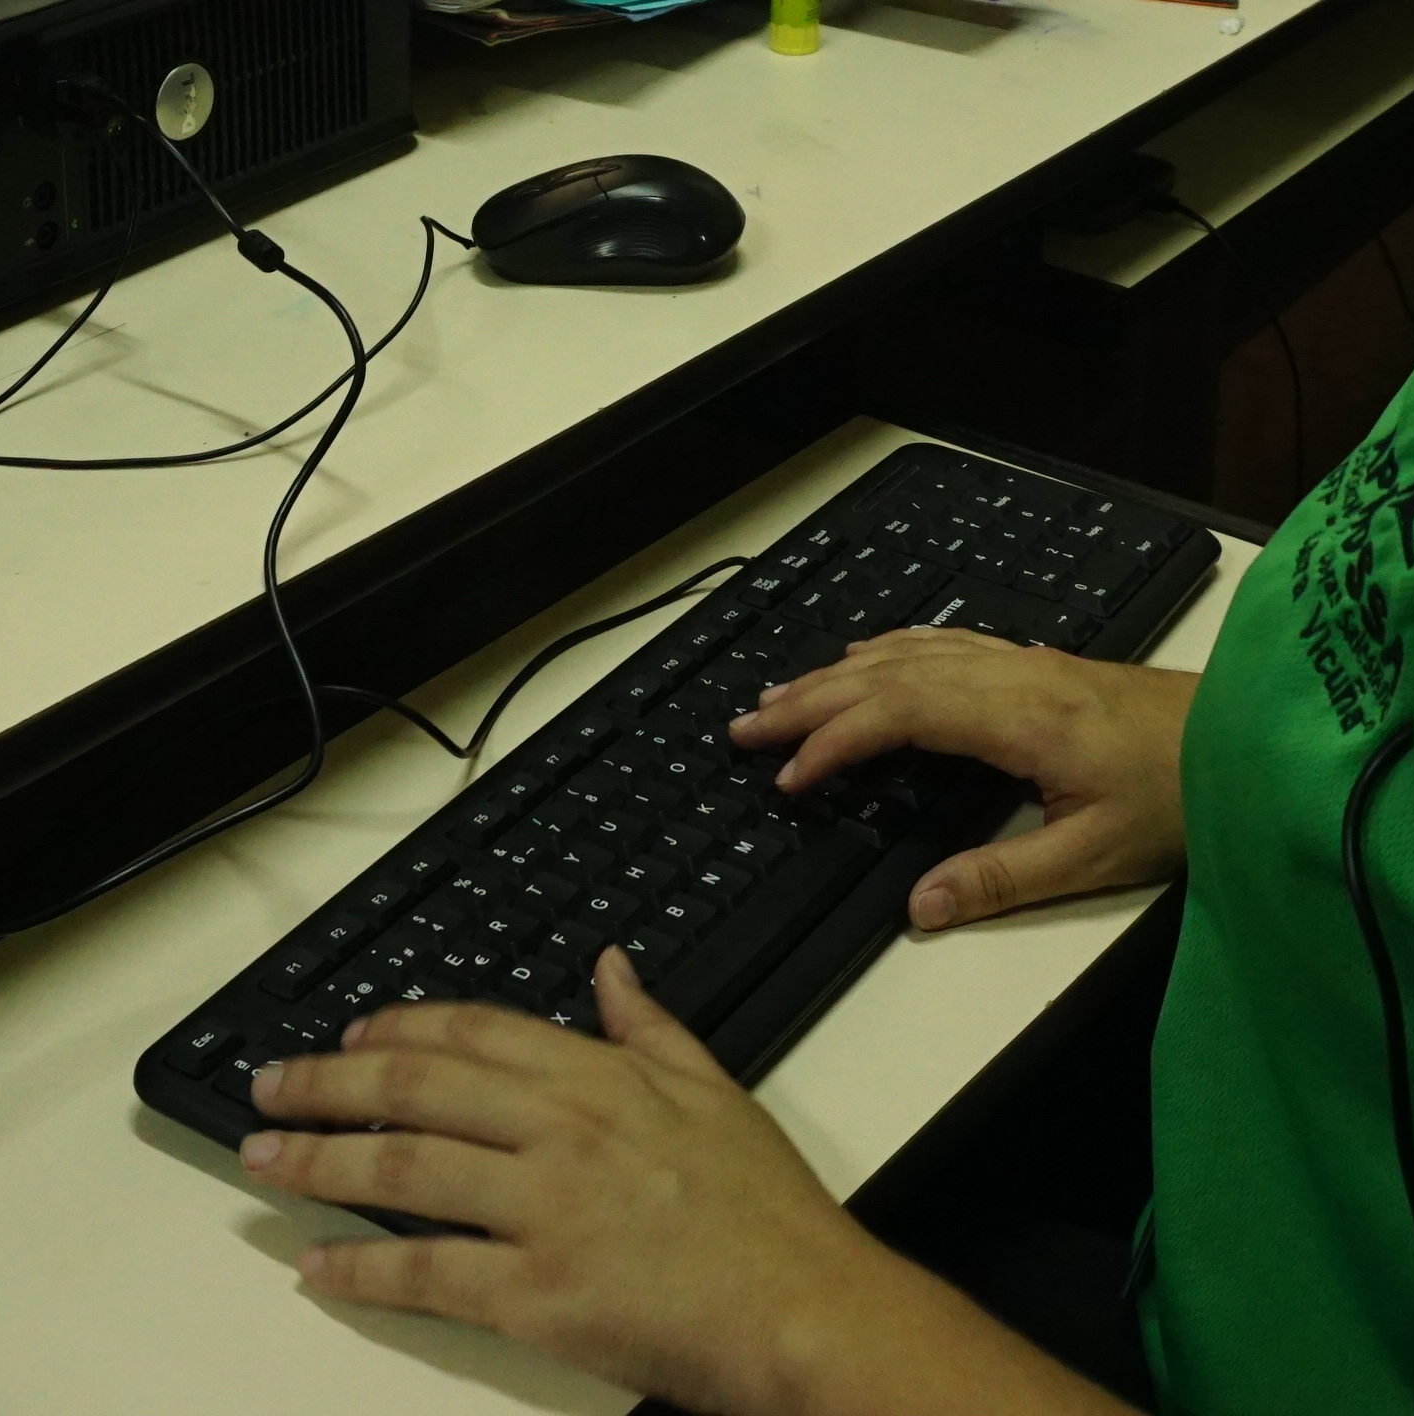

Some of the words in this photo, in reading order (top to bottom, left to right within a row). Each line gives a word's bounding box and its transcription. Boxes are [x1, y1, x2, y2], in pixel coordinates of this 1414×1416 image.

[722, 610, 739, 620] F12
[929, 597, 967, 626] VORTTEK
[692, 634, 709, 645] F11
[662, 659, 679, 671] F10
[630, 687, 644, 697] F9
[580, 727, 595, 737] F8
[701, 734, 715, 744] P
[546, 754, 560, 764] F7
[669, 763, 686, 773] O
[729, 777, 748, 785] L
[696, 803, 715, 815] K
[473, 813, 489, 825] F5
[599, 821, 617, 832] U
[664, 835, 678, 846] J
[733, 840, 755, 854] M
[563, 852, 580, 863] Y
[412, 861, 429, 872] F4
[625, 866, 645, 879] H
[701, 872, 721, 885] N
[525, 884, 542, 895] T
[371, 893, 388, 905] F3
[590, 898, 609, 910] G
[665, 906, 685, 918] B
[488, 920, 508, 932] R
[330, 927, 347, 939] F2
[551, 932, 566, 945] F
[626, 939, 646, 951] V
[443, 953, 465, 967] E
[285, 962, 302, 974] F1
[511, 967, 531, 980] D
[401, 984, 425, 1000] W
[549, 1011, 572, 1026] X
[191, 1032, 215, 1048] Esc
